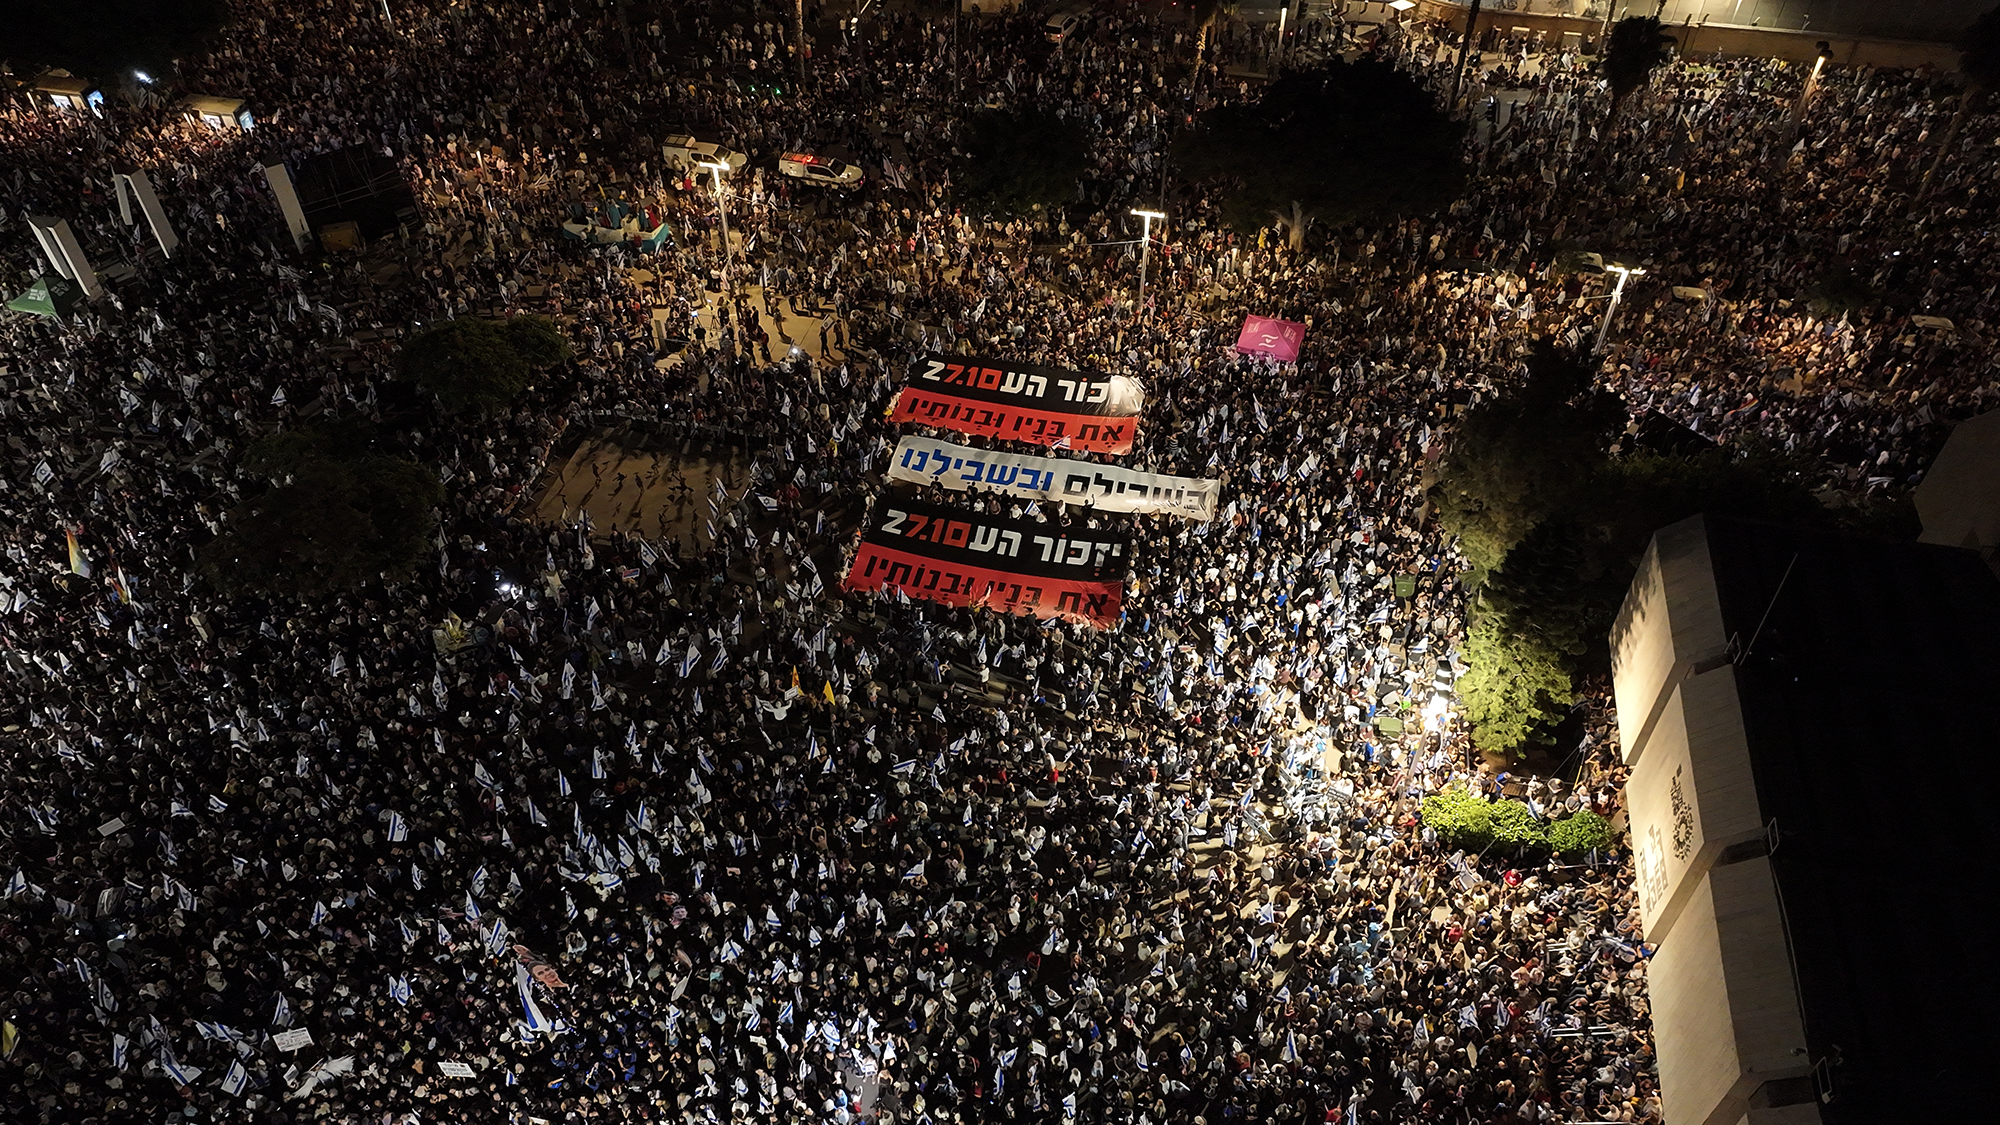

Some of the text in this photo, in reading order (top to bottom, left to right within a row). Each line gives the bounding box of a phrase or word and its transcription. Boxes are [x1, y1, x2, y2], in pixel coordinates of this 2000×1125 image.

[906, 397, 1125, 445] את בניו ובנותיו
[898, 446, 1055, 492] ובשבילנו
[1032, 534, 1122, 569] יזכור
[863, 555, 976, 597] ובנותיו
[1053, 591, 1109, 616] את
